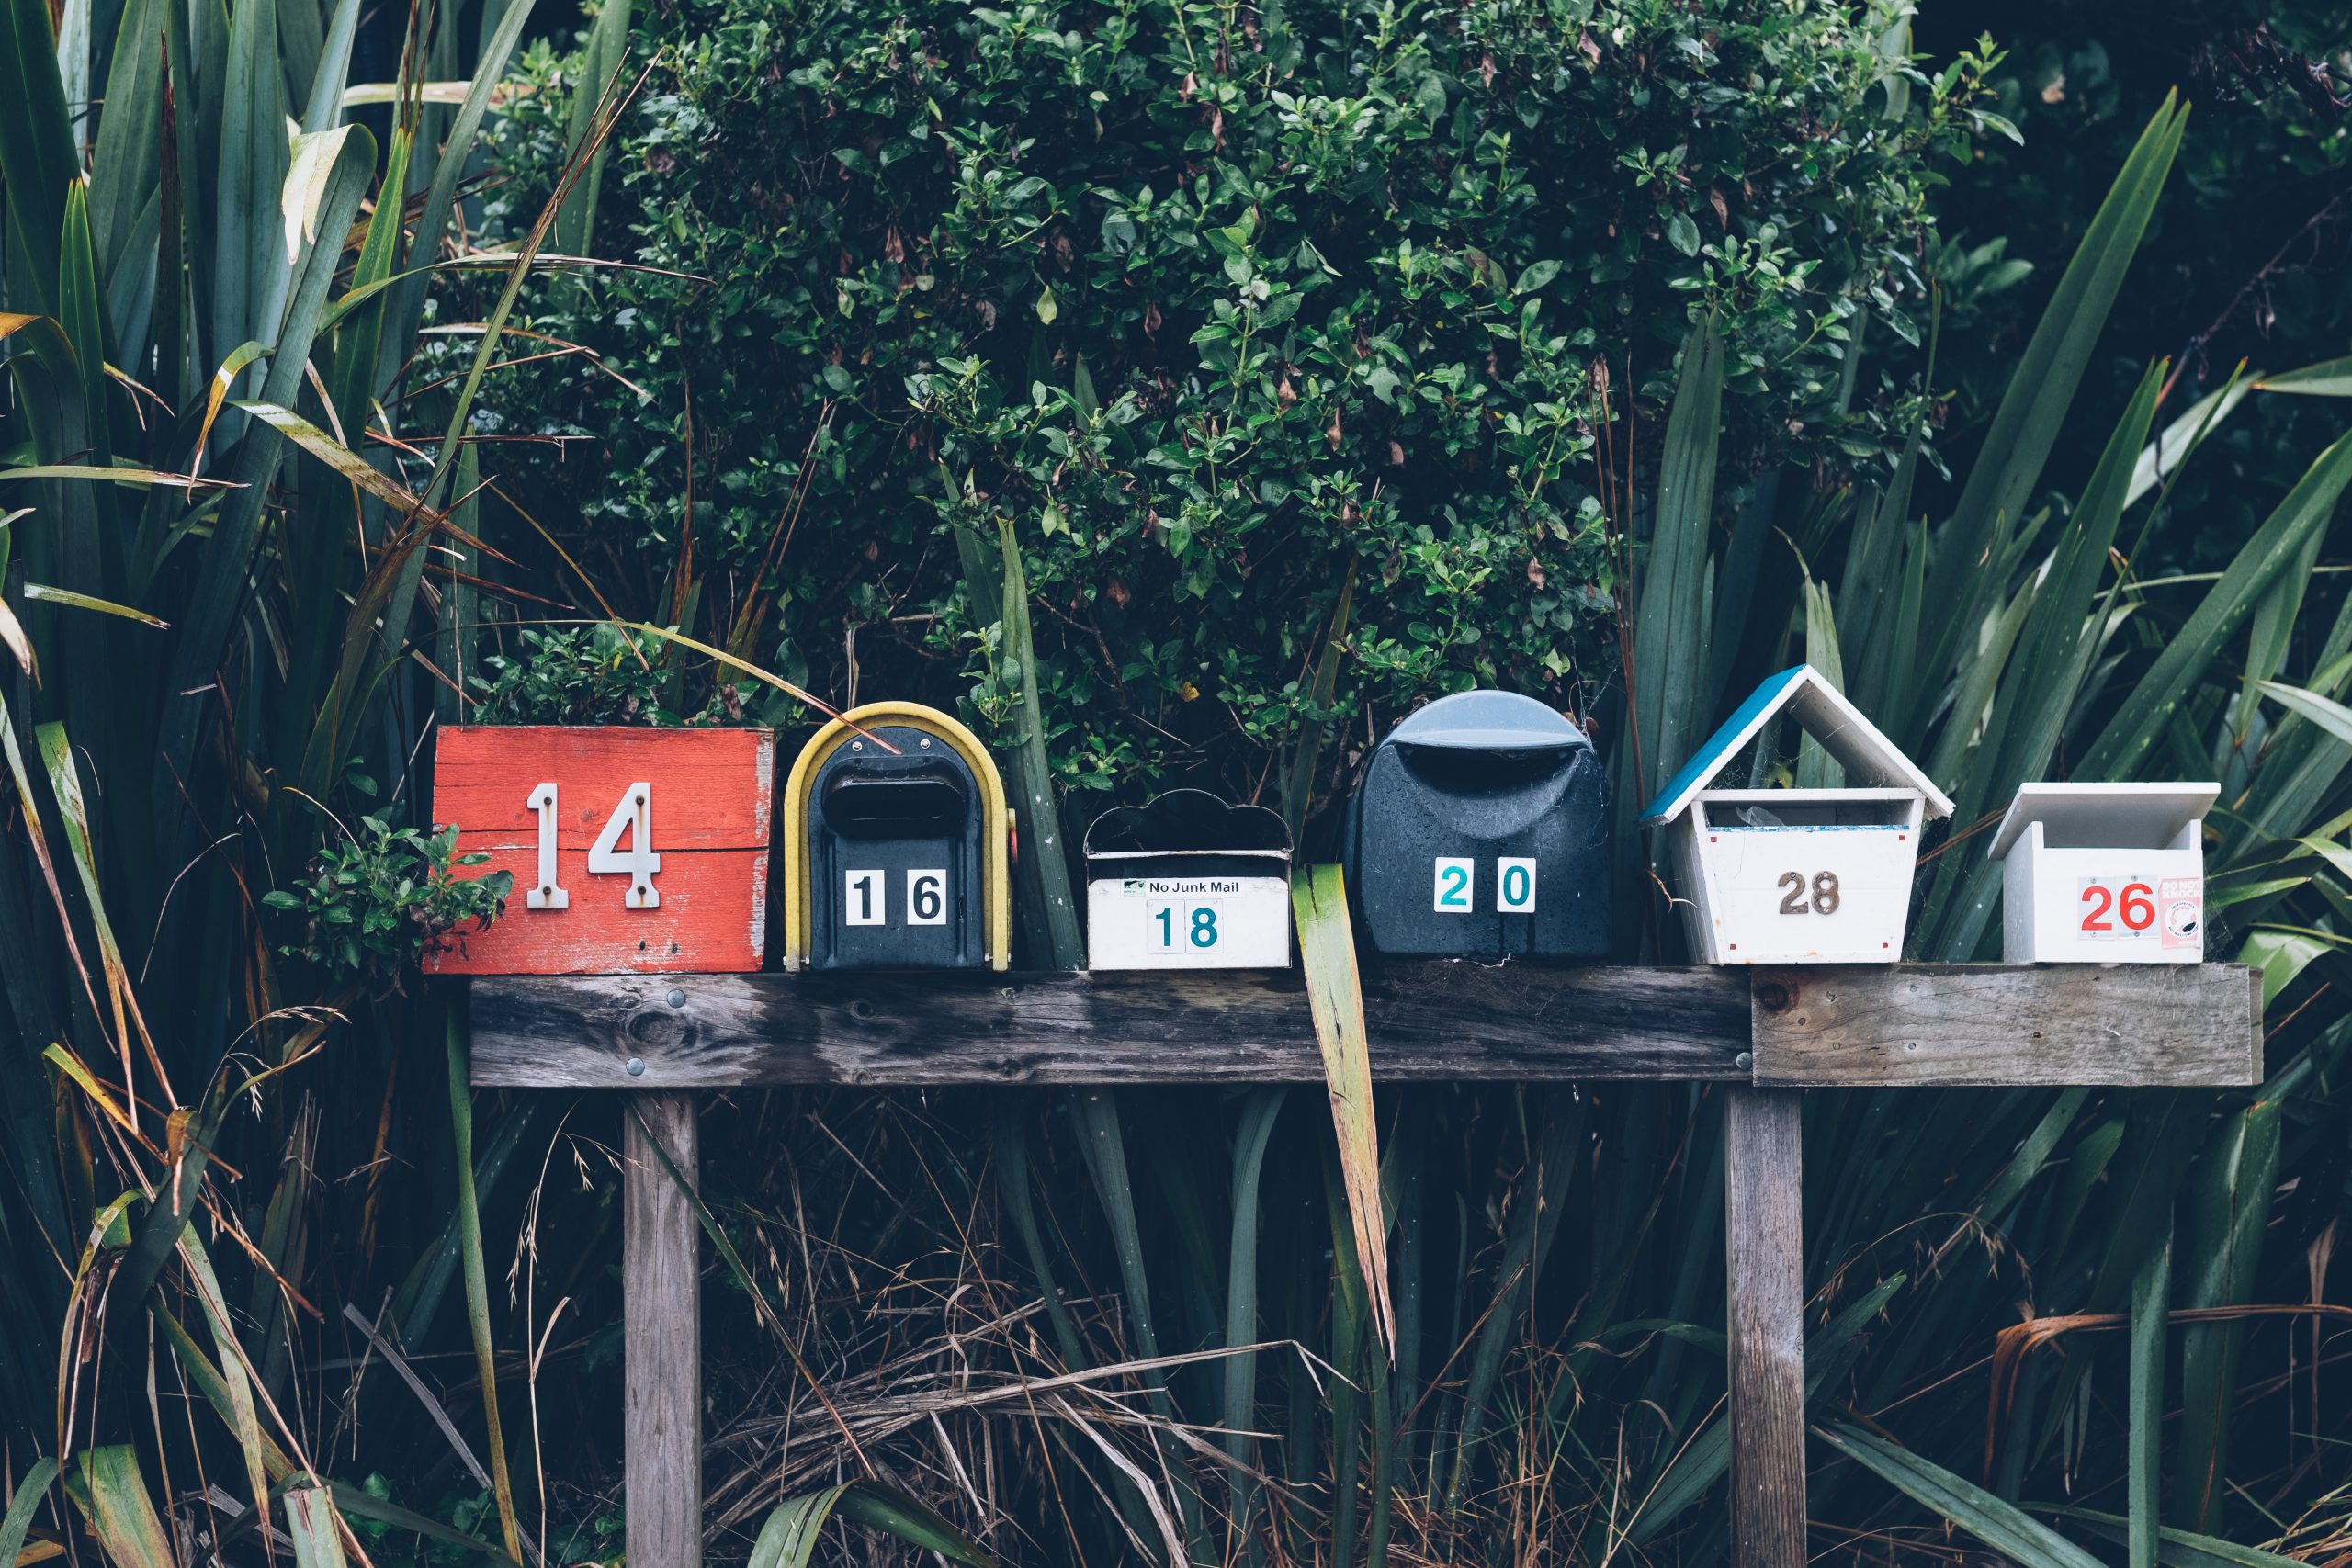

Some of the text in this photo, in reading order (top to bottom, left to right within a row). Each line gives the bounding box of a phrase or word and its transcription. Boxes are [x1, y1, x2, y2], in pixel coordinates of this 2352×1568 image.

[526, 782, 661, 908] 14
[853, 875, 941, 919] 16
[1149, 882, 1170, 893] No
[1172, 882, 1207, 893] Junk
[1210, 881, 1239, 893] Mail
[1440, 865, 1531, 907] 20
[1777, 870, 1840, 915] 28
[2081, 883, 2156, 931] 26
[1156, 907, 1218, 948] 18
